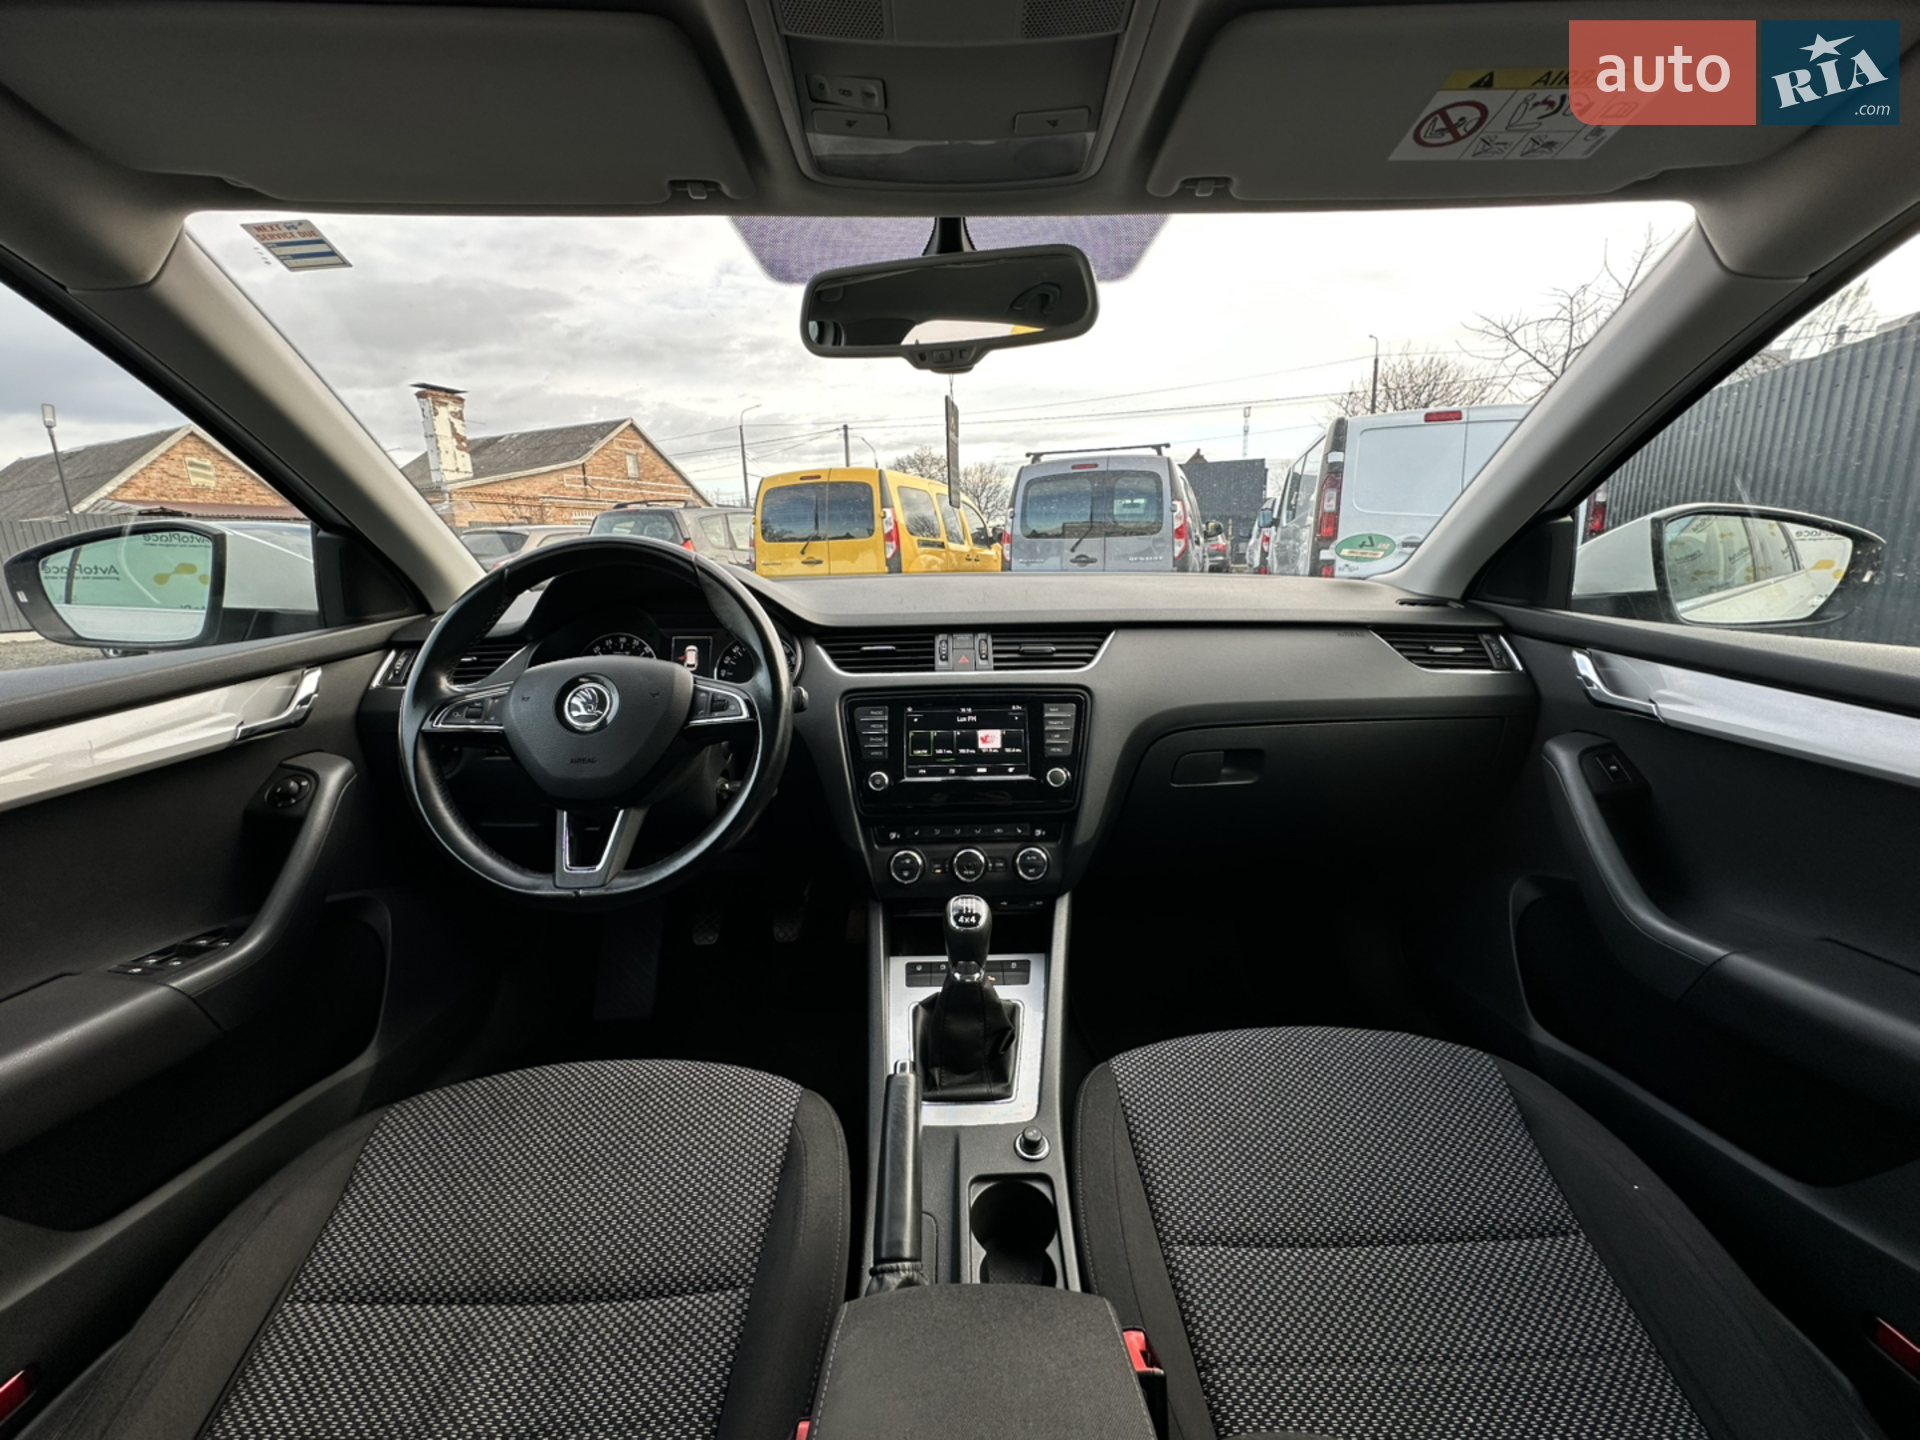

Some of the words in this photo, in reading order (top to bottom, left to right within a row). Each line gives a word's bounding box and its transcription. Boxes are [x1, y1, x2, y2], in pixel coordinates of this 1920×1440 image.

[254, 225, 283, 233] NEXT
[257, 232, 296, 241] SERVICE
[298, 230, 319, 239] DUE
[958, 914, 977, 924] 4x4
